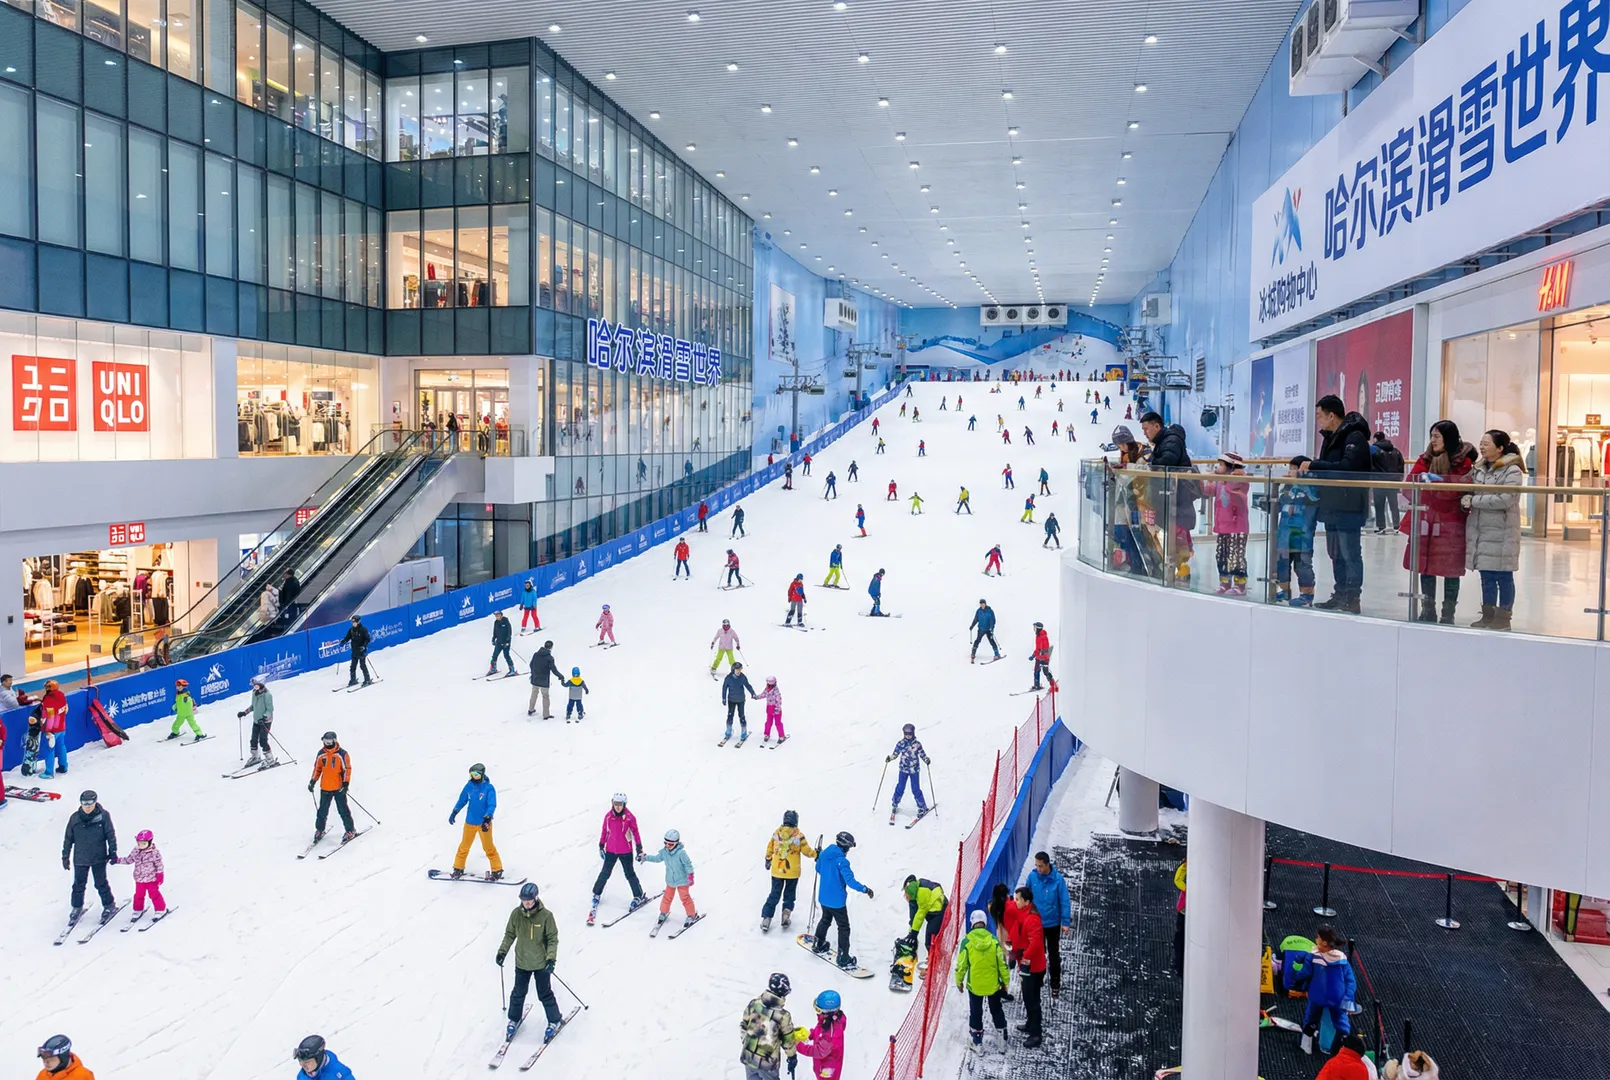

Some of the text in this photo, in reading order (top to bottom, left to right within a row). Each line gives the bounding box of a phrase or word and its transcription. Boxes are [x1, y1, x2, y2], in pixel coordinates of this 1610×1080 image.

[1324, 0, 1610, 261] 哈尔滨滑雪世界
[1537, 260, 1571, 312] H&M
[587, 317, 722, 388] 哈尔滨滑雪世界
[100, 370, 140, 396] UNI
[100, 399, 144, 427] QLO
